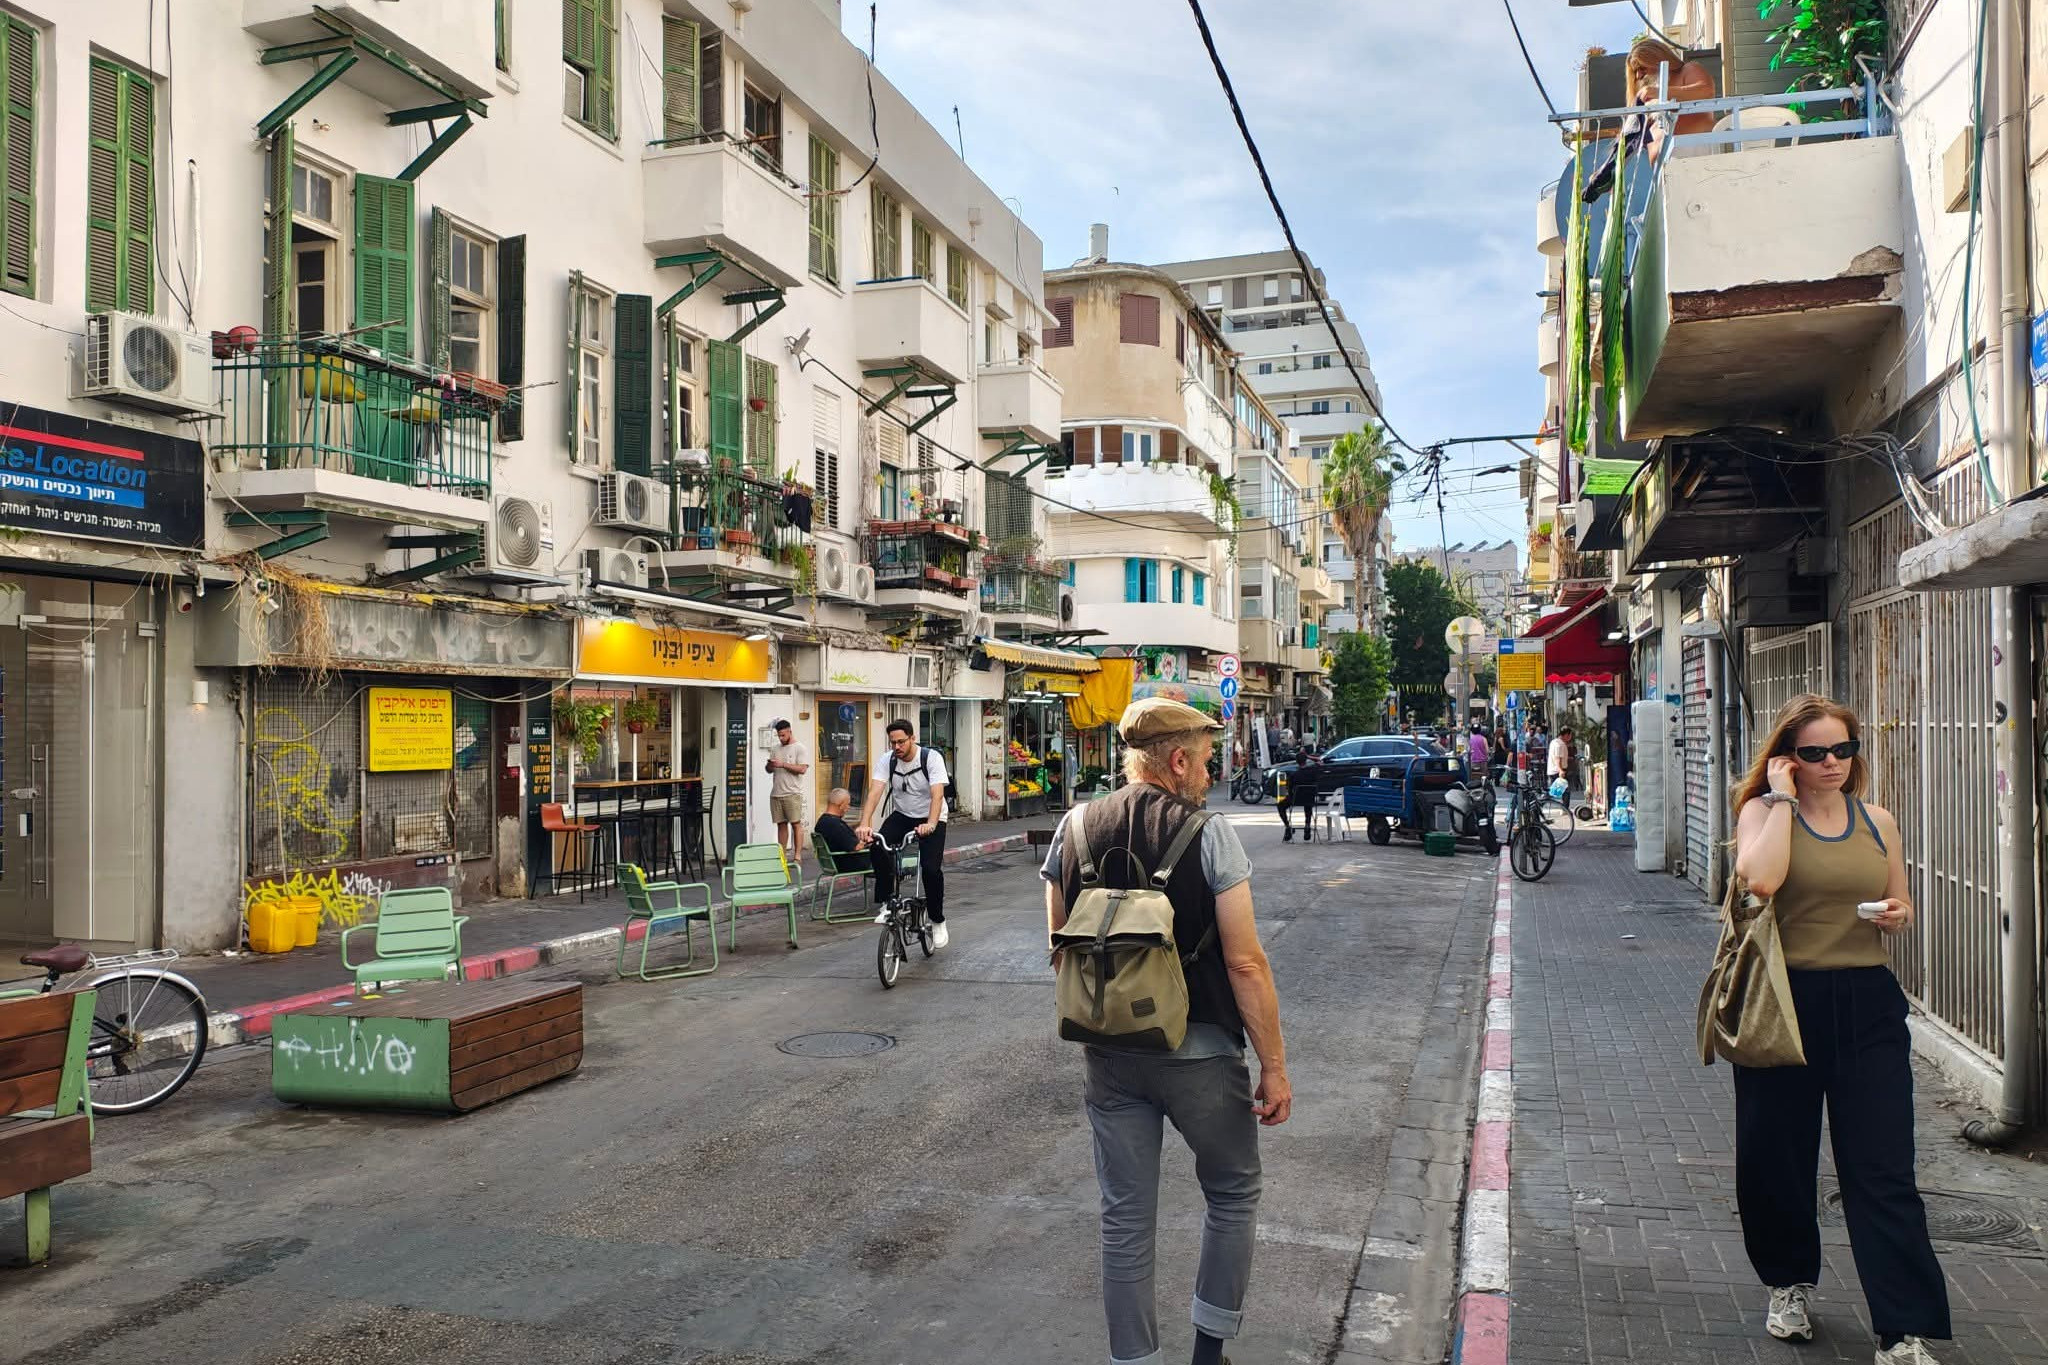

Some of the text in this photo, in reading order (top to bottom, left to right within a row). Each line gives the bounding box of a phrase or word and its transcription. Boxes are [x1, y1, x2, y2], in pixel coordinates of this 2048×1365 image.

[0, 474, 115, 501] תיווך נכסים והשק
[35, 504, 59, 519] ניהול
[63, 511, 98, 526] מגרשים
[102, 515, 133, 530] השכרה
[136, 520, 162, 534] מכירה
[419, 697, 446, 709] דפוס
